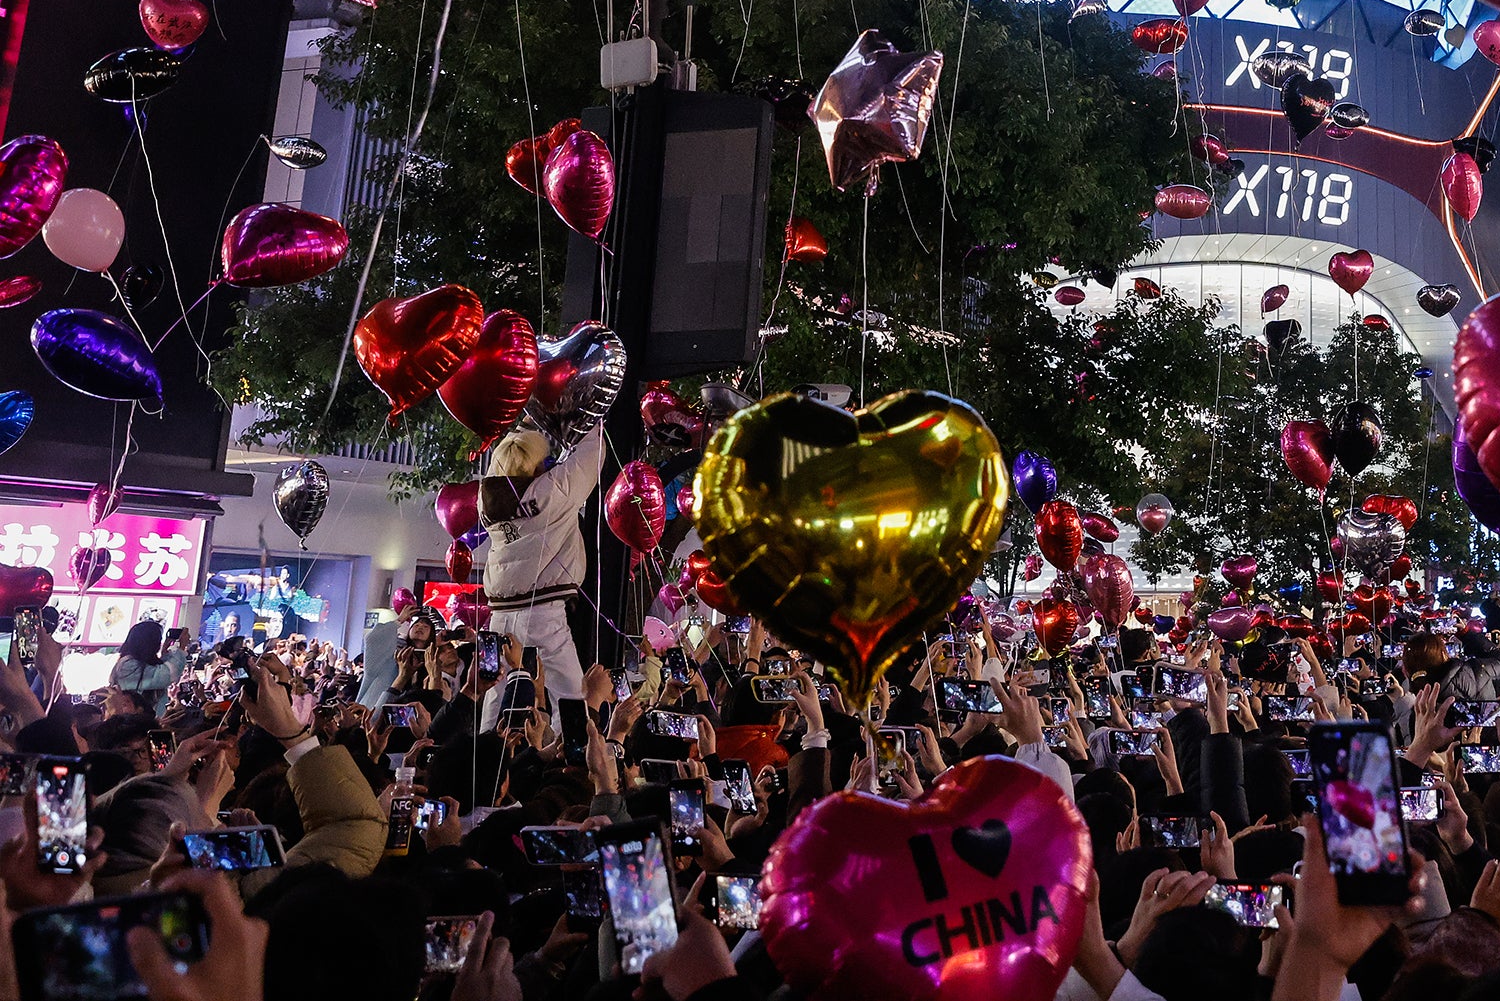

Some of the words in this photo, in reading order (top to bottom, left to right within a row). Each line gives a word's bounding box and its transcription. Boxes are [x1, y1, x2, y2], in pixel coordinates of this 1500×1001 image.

[1223, 164, 1353, 226] X118
[393, 800, 412, 811] NFC
[908, 834, 948, 903] I
[902, 885, 1060, 967] CHINA
